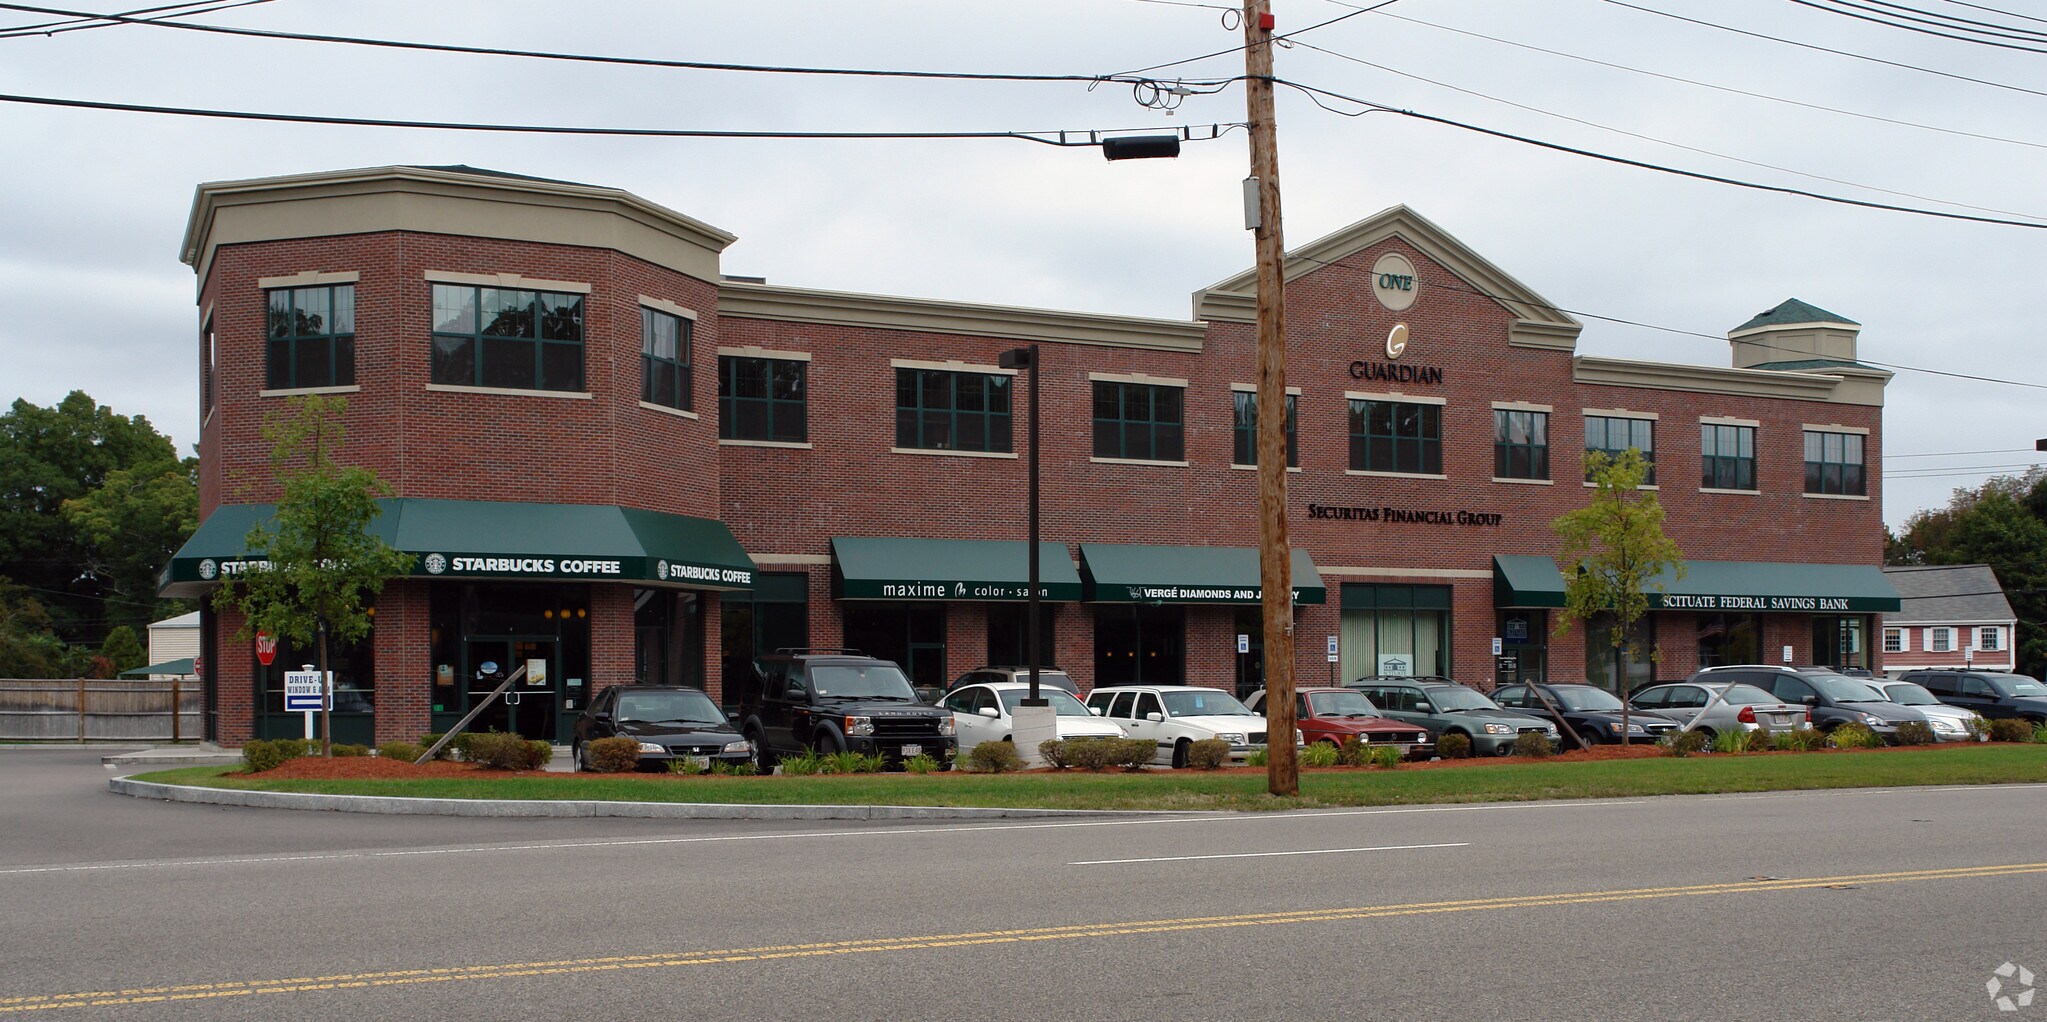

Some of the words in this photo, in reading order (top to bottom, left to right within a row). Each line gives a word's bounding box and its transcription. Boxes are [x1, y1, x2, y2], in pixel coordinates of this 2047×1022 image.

[1379, 273, 1413, 291] ONE
[1350, 361, 1443, 384] GUARDIAN
[452, 557, 555, 572] STARBUCKS
[560, 560, 621, 574] COFFEE
[670, 564, 720, 581] STARBUCKS
[722, 569, 751, 583] COFFEE
[883, 581, 945, 597] maxime
[974, 585, 1005, 597] color
[1016, 588, 1048, 597] san
[1144, 586, 1178, 598] VERGÉ
[1180, 589, 1232, 599] DIAMONDS
[1233, 590, 1254, 599] AND
[1663, 595, 1716, 608] SCITUATE
[1720, 597, 1767, 609] FEDERAL
[1771, 598, 1816, 609] SAVINGS
[1820, 599, 1849, 610] BANK
[258, 635, 275, 654] STOP
[289, 675, 323, 684] DRIVE-U
[287, 685, 311, 694] WINDOW
